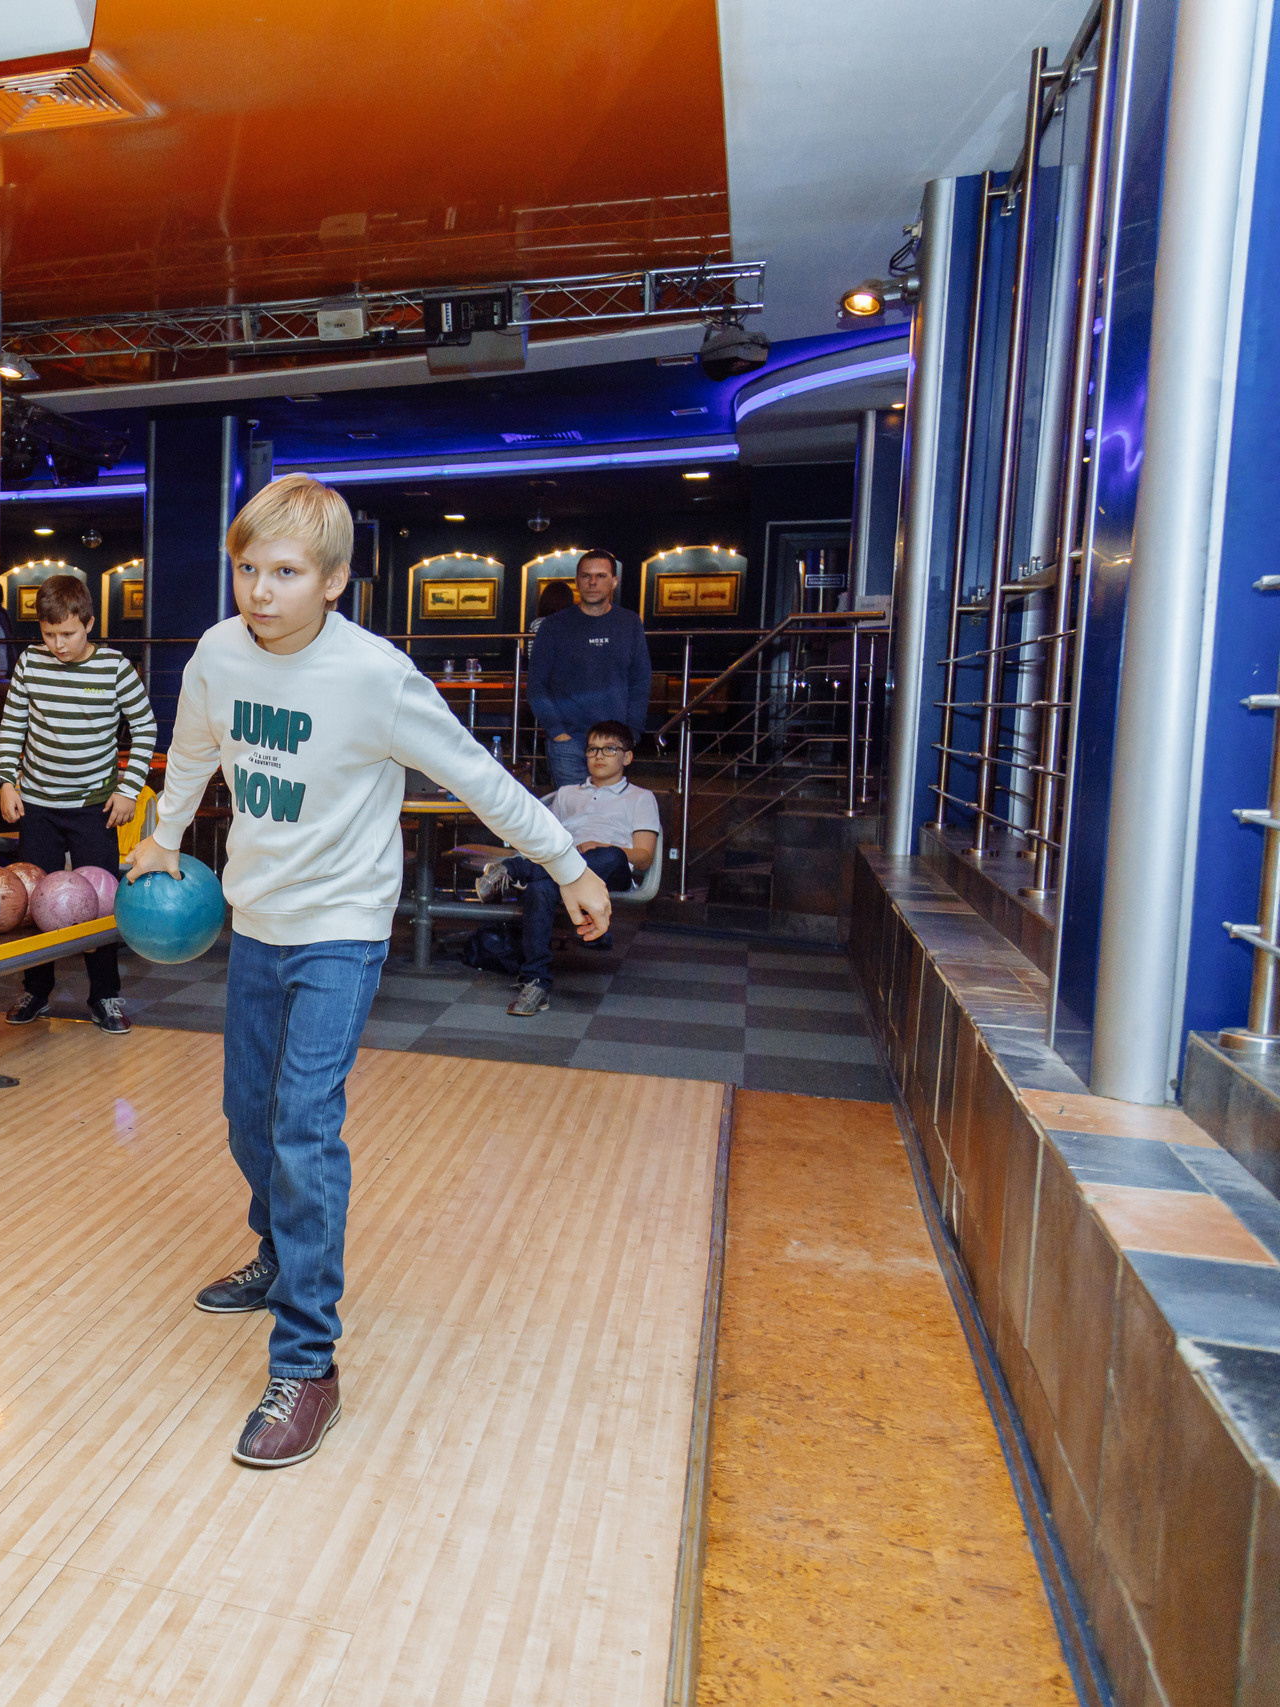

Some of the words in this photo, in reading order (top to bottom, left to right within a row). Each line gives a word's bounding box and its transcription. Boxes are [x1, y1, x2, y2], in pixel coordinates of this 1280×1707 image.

[84, 687, 107, 695] MOVE
[230, 700, 312, 755] JUMP
[254, 758, 282, 769] ADVENTURES
[234, 763, 306, 823] NOW
